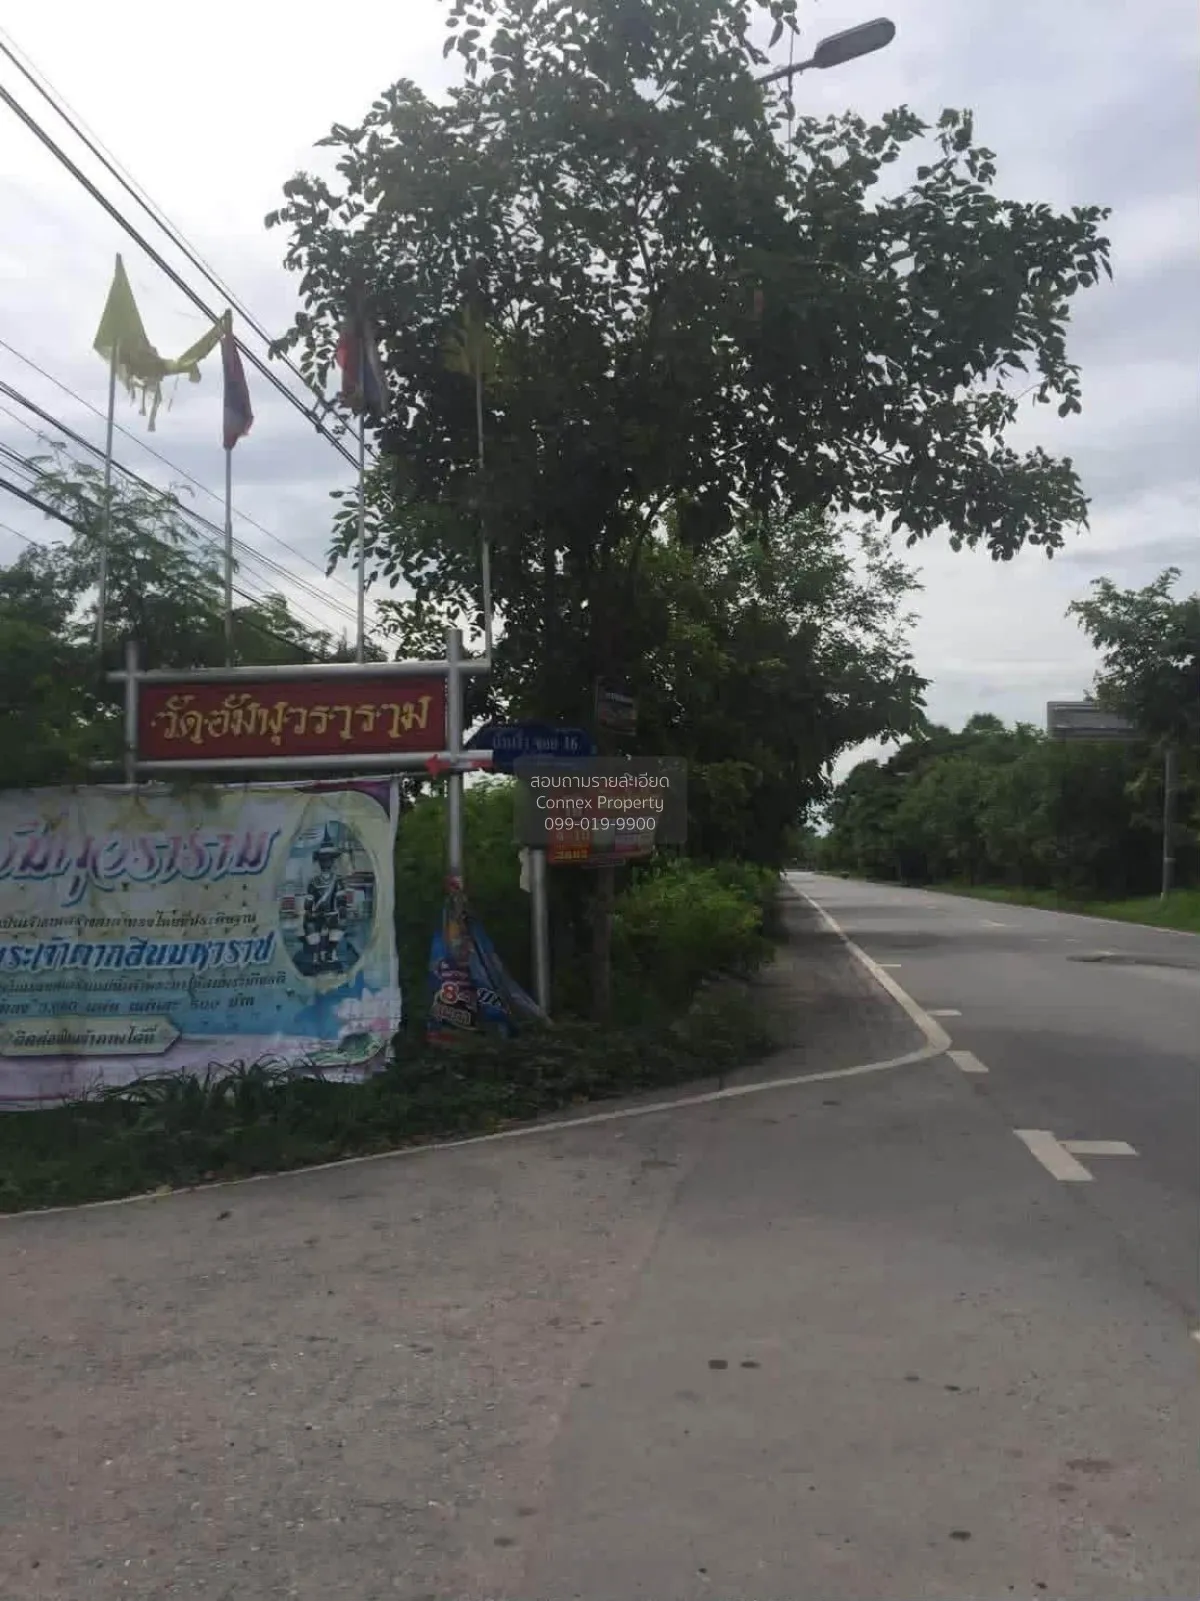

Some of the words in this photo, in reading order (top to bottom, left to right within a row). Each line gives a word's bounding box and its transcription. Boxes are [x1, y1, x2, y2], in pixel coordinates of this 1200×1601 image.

[151, 694, 433, 746] วัดอัมพุวราราม
